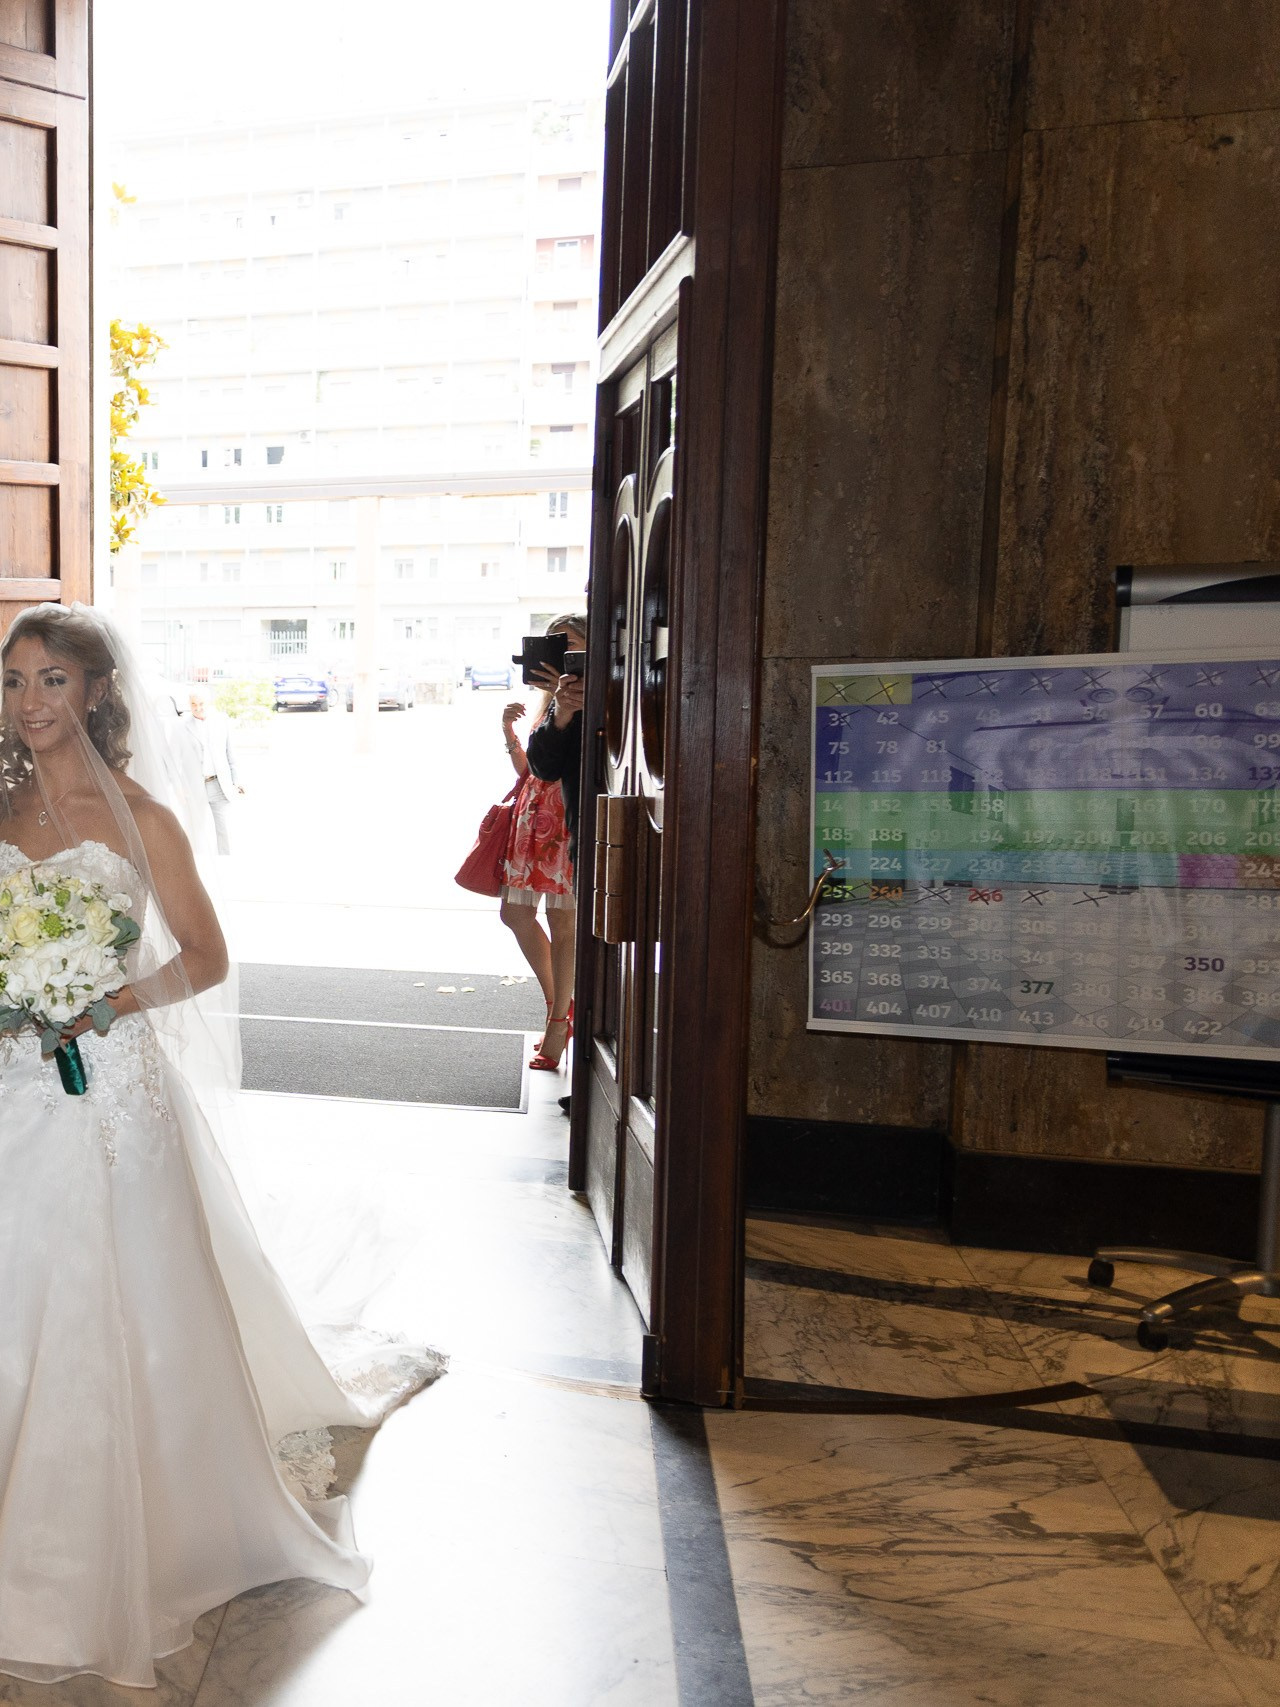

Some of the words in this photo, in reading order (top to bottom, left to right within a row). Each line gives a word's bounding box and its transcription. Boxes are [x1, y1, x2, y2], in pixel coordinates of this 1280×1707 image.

[876, 711, 899, 725] 42
[976, 708, 1001, 723] 48
[1082, 706, 1109, 721] 54
[1140, 704, 1164, 719] 57
[1194, 703, 1223, 718] 60
[828, 741, 850, 755] 75
[876, 740, 899, 754] 78
[926, 739, 948, 753] 81
[1253, 733, 1280, 750] 99
[824, 770, 853, 784] 112
[871, 769, 902, 783] 115
[921, 769, 952, 783] 118
[1187, 767, 1228, 781] 134
[870, 799, 902, 812] 152
[970, 798, 1004, 812] 158
[1188, 798, 1227, 813] 170
[822, 828, 853, 841] 185
[870, 828, 903, 841] 188
[970, 829, 1004, 843] 194
[1022, 829, 1056, 844] 197
[1130, 830, 1169, 845] 203
[1186, 830, 1228, 846] 206
[870, 857, 902, 871] 224
[969, 858, 1004, 872] 230
[968, 888, 1003, 902] 266
[1186, 893, 1224, 908] 278
[821, 913, 853, 927] 293
[869, 915, 902, 929] 296
[918, 916, 951, 930] 299
[1020, 920, 1057, 934] 305
[821, 941, 853, 956] 329
[869, 943, 902, 958] 332
[918, 945, 951, 960] 335
[968, 948, 1003, 962] 338
[1020, 949, 1055, 965] 341
[1184, 956, 1225, 973] 350
[820, 970, 853, 984] 365
[867, 972, 902, 987] 368
[918, 975, 950, 990] 371
[967, 977, 1002, 992] 374
[1020, 979, 1054, 995] 377
[1071, 982, 1111, 998] 380
[1127, 985, 1166, 1001] 383
[1183, 988, 1225, 1005] 386
[820, 998, 852, 1013] 401
[867, 1001, 902, 1016] 404
[916, 1004, 951, 1019] 407
[966, 1007, 1002, 1022] 410
[1019, 1010, 1055, 1025] 413
[1070, 1013, 1110, 1029] 416
[1126, 1017, 1165, 1033] 419
[1183, 1020, 1222, 1036] 422
